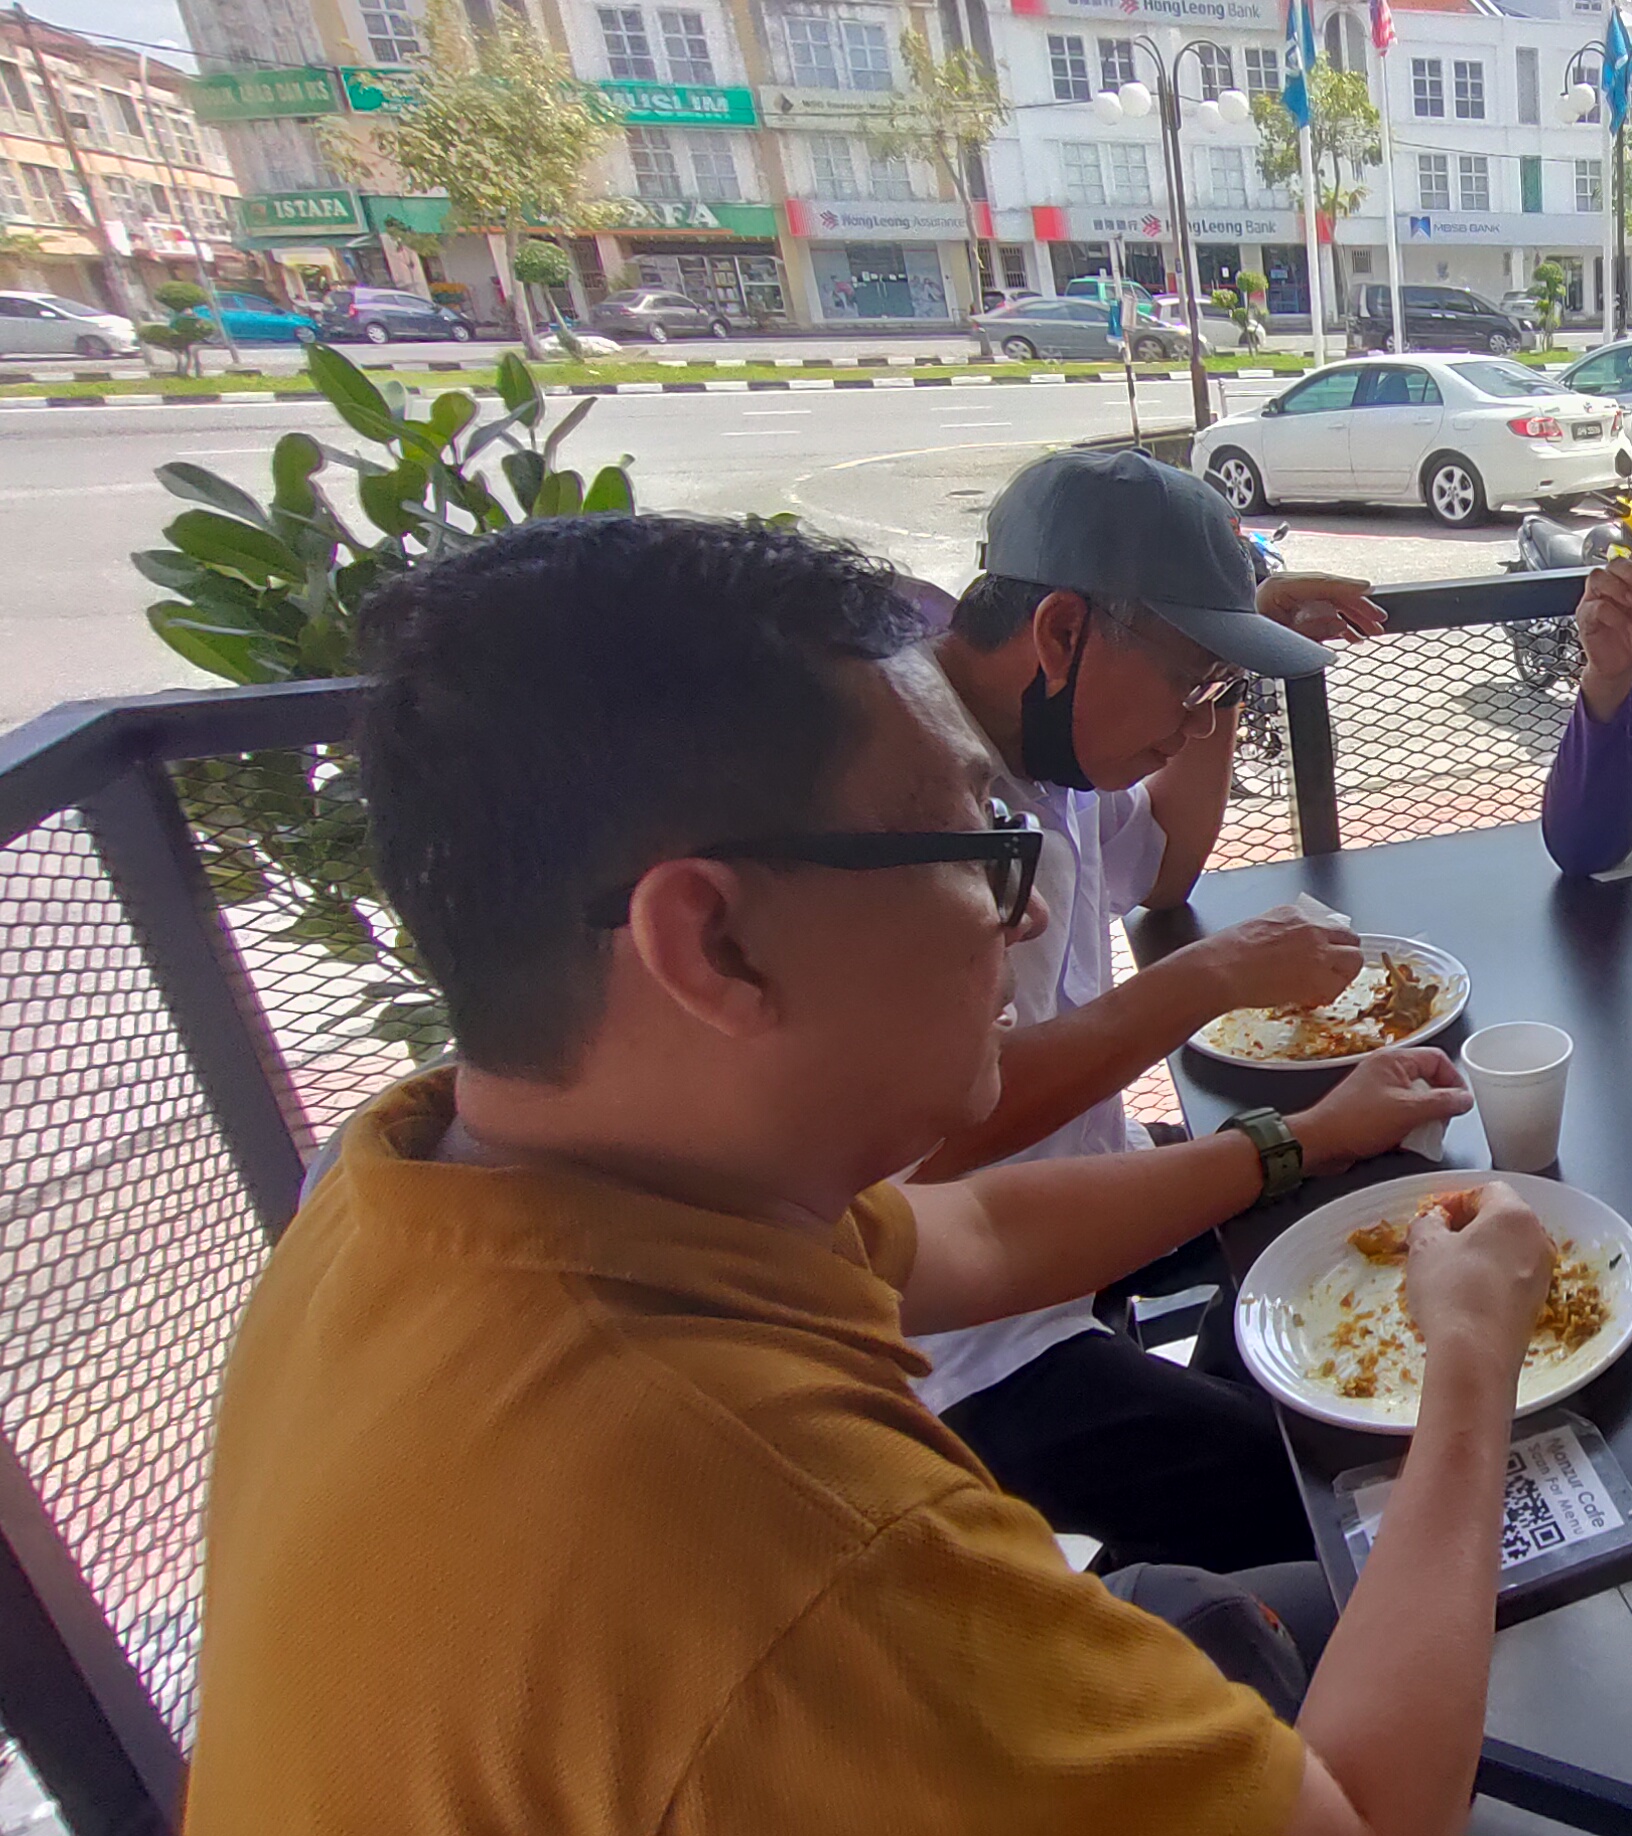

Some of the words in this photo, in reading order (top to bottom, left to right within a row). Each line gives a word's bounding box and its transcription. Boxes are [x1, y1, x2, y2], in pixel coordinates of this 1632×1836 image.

[1228, 2, 1260, 19] Bank
[273, 198, 349, 219] ISTAFA
[1166, 219, 1243, 237] ngLeong
[1246, 219, 1277, 234] Bank
[1527, 1442, 1551, 1476] Scan
[1544, 1476, 1563, 1496] For
[1558, 1499, 1585, 1536] Menu
[1549, 1437, 1585, 1489] Manzur
[1577, 1491, 1606, 1528] Cafe
